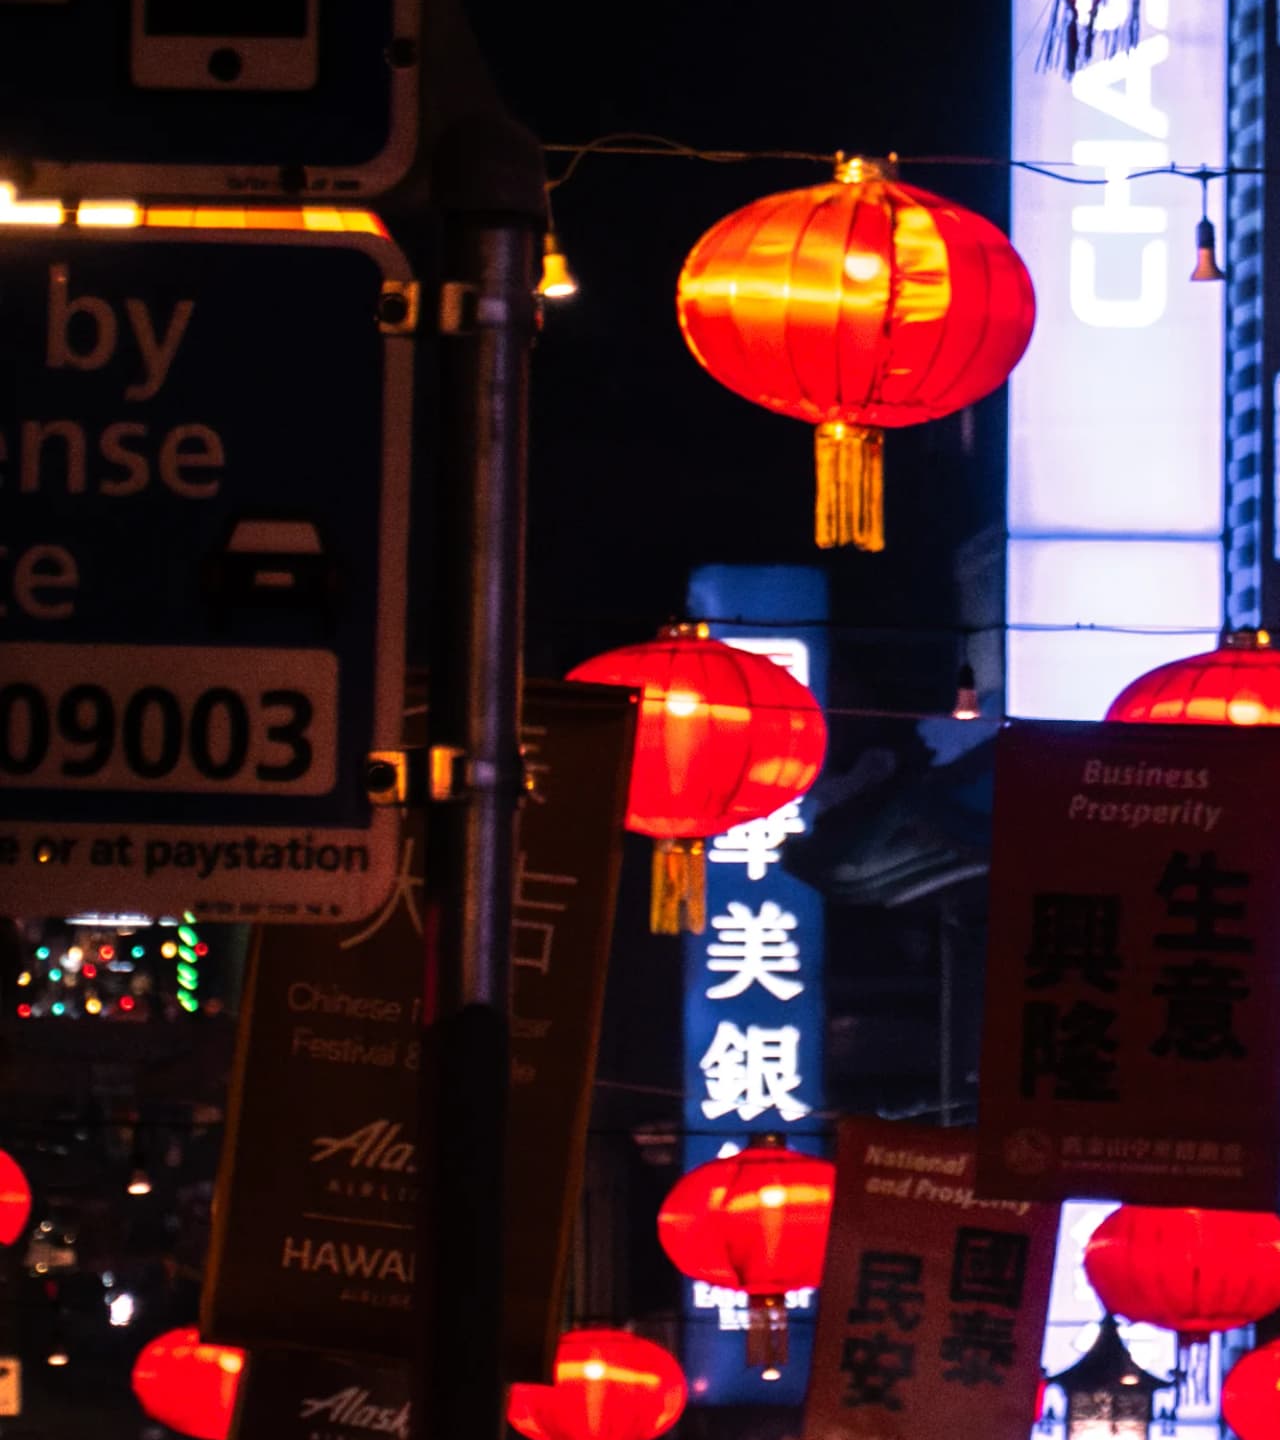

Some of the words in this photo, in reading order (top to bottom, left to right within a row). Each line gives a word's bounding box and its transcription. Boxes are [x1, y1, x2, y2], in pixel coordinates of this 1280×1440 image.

[44, 262, 195, 403] by
[0, 418, 226, 500] nse
[0, 540, 80, 621] e
[0, 681, 314, 784] 09003
[1067, 792, 1224, 833] Prosperity
[1081, 758, 1211, 792] Business
[90, 836, 134, 867] at
[145, 835, 370, 878] paystation
[700, 796, 812, 1156] 華美銀
[1151, 849, 1256, 1063] 生意
[1019, 891, 1124, 1104] 興隆
[308, 1118, 418, 1175] Ala
[279, 1232, 417, 1285] HAWAI
[299, 1384, 412, 1440] Alask
